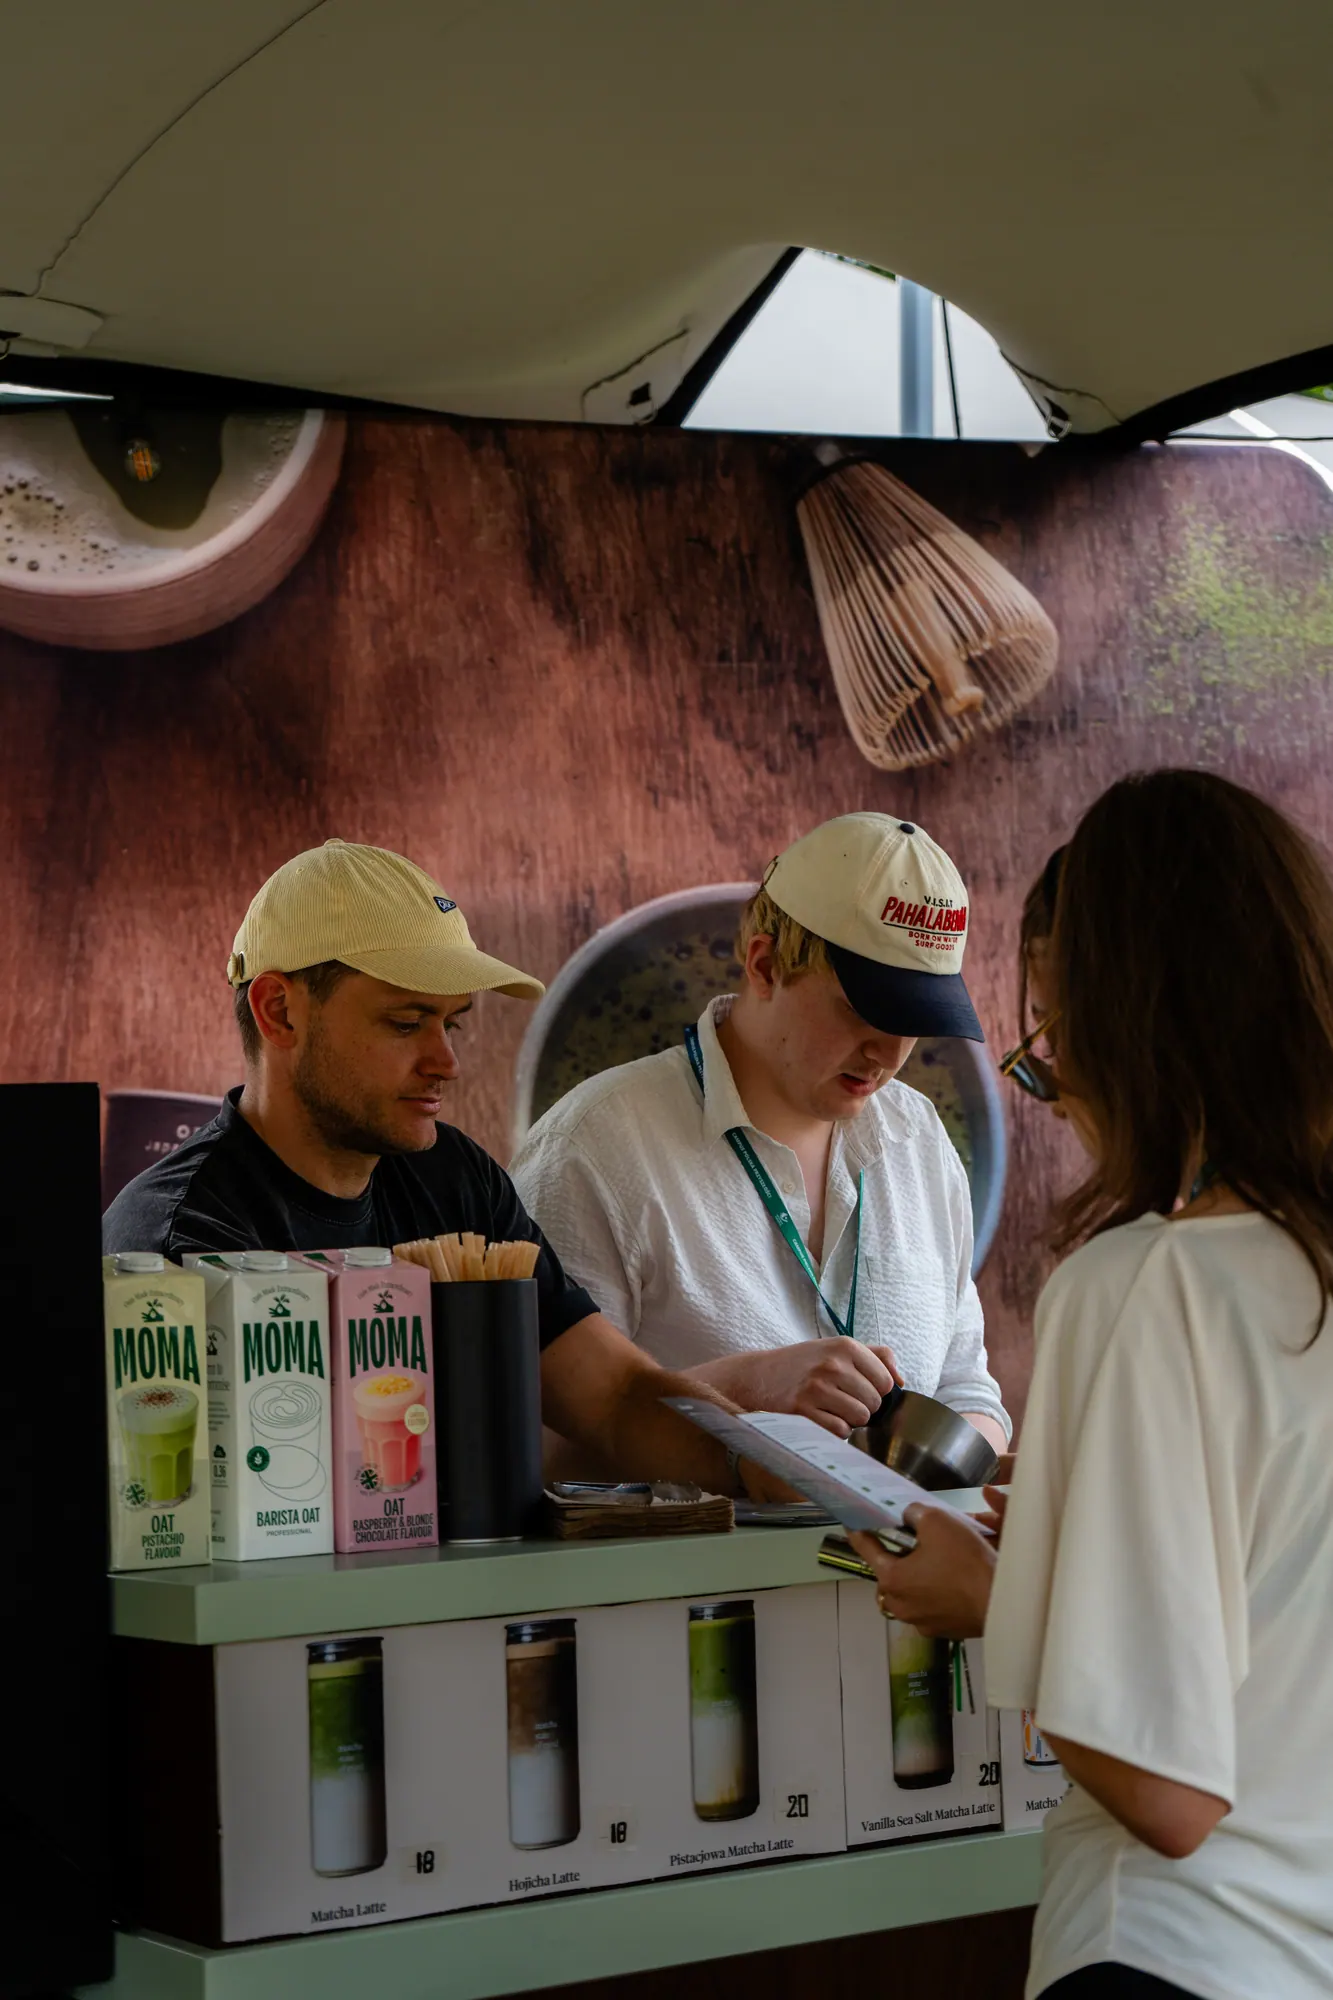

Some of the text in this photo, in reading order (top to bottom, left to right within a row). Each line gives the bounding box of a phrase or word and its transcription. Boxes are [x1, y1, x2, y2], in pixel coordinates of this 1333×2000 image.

[908, 931, 930, 941] BORN
[915, 940, 934, 949] SURF
[731, 1131, 745, 1152] CAMPUS
[742, 1149, 755, 1169] POLSKA
[113, 1325, 201, 1389] MOMA
[243, 1320, 325, 1384] MOMA
[348, 1315, 428, 1378] MOMA
[256, 1507, 320, 1527] BARISTA OAT
[384, 1498, 405, 1516] OAT
[151, 1514, 175, 1533] OAT
[353, 1513, 434, 1531] RASPBERRY & BLONDE
[141, 1532, 185, 1547] PISTACHIO
[355, 1526, 433, 1544] CHOCOLATE FLAVOUR
[145, 1546, 181, 1560] FLAVOUR
[978, 1761, 1000, 1786] 20
[786, 1794, 809, 1818] 20
[1025, 1797, 1058, 1812] Matcha
[861, 1803, 996, 1832] Vanilla Sea Salt Matcha Latte
[610, 1821, 627, 1844] 18
[416, 1850, 435, 1874] 18
[669, 1838, 794, 1867] Pistacjowa Matcha Latte
[509, 1871, 580, 1892] Hojicha Latte
[310, 1902, 387, 1924] Matcha Latte
